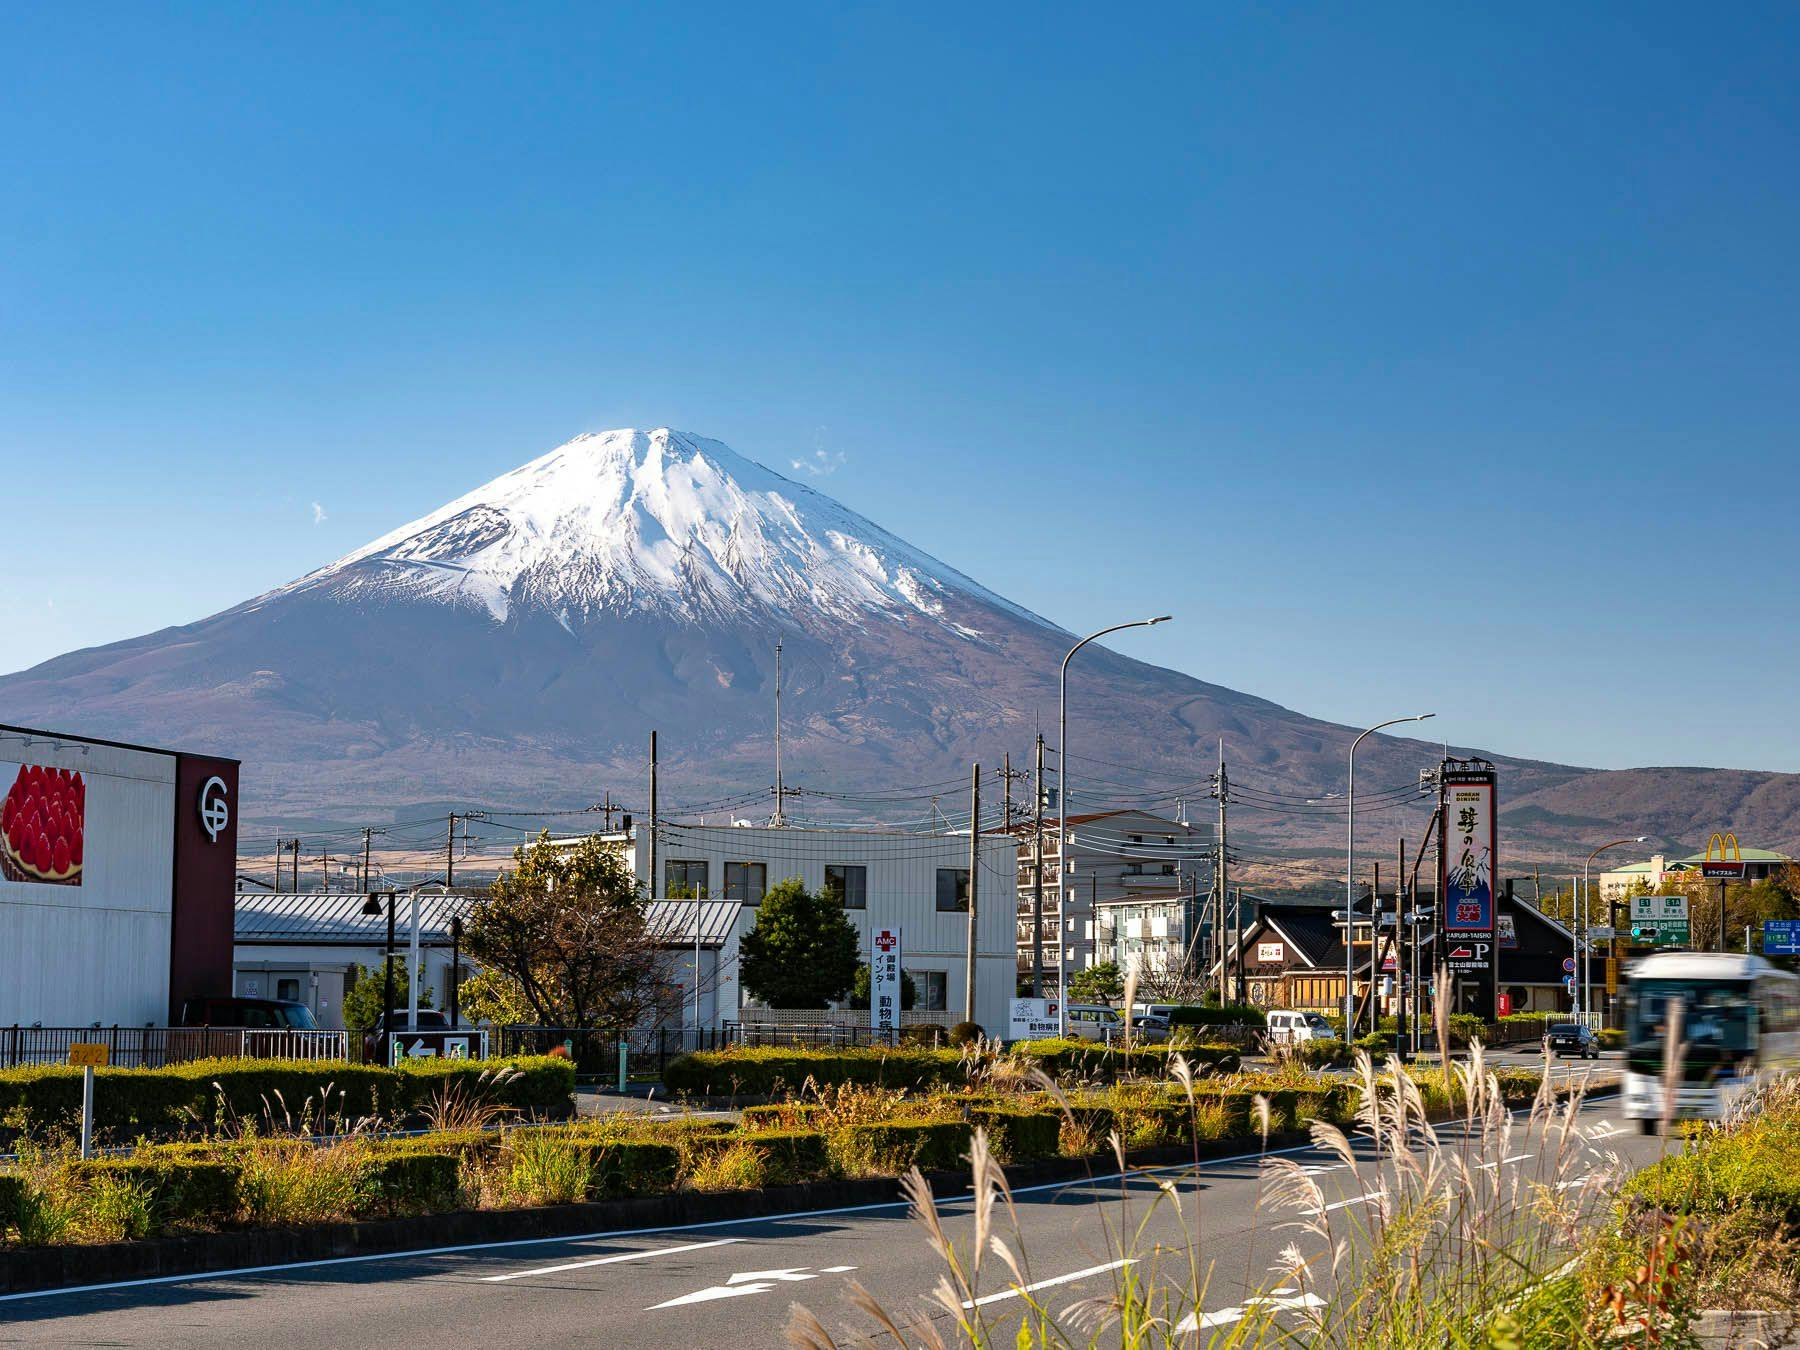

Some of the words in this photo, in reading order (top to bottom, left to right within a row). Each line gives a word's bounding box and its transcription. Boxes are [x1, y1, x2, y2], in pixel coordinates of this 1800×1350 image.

[876, 937, 895, 945] AMC
[1474, 943, 1490, 961] P
[875, 955, 885, 992] インター
[886, 955, 896, 982] 御殿場
[1048, 1004, 1058, 1016] P
